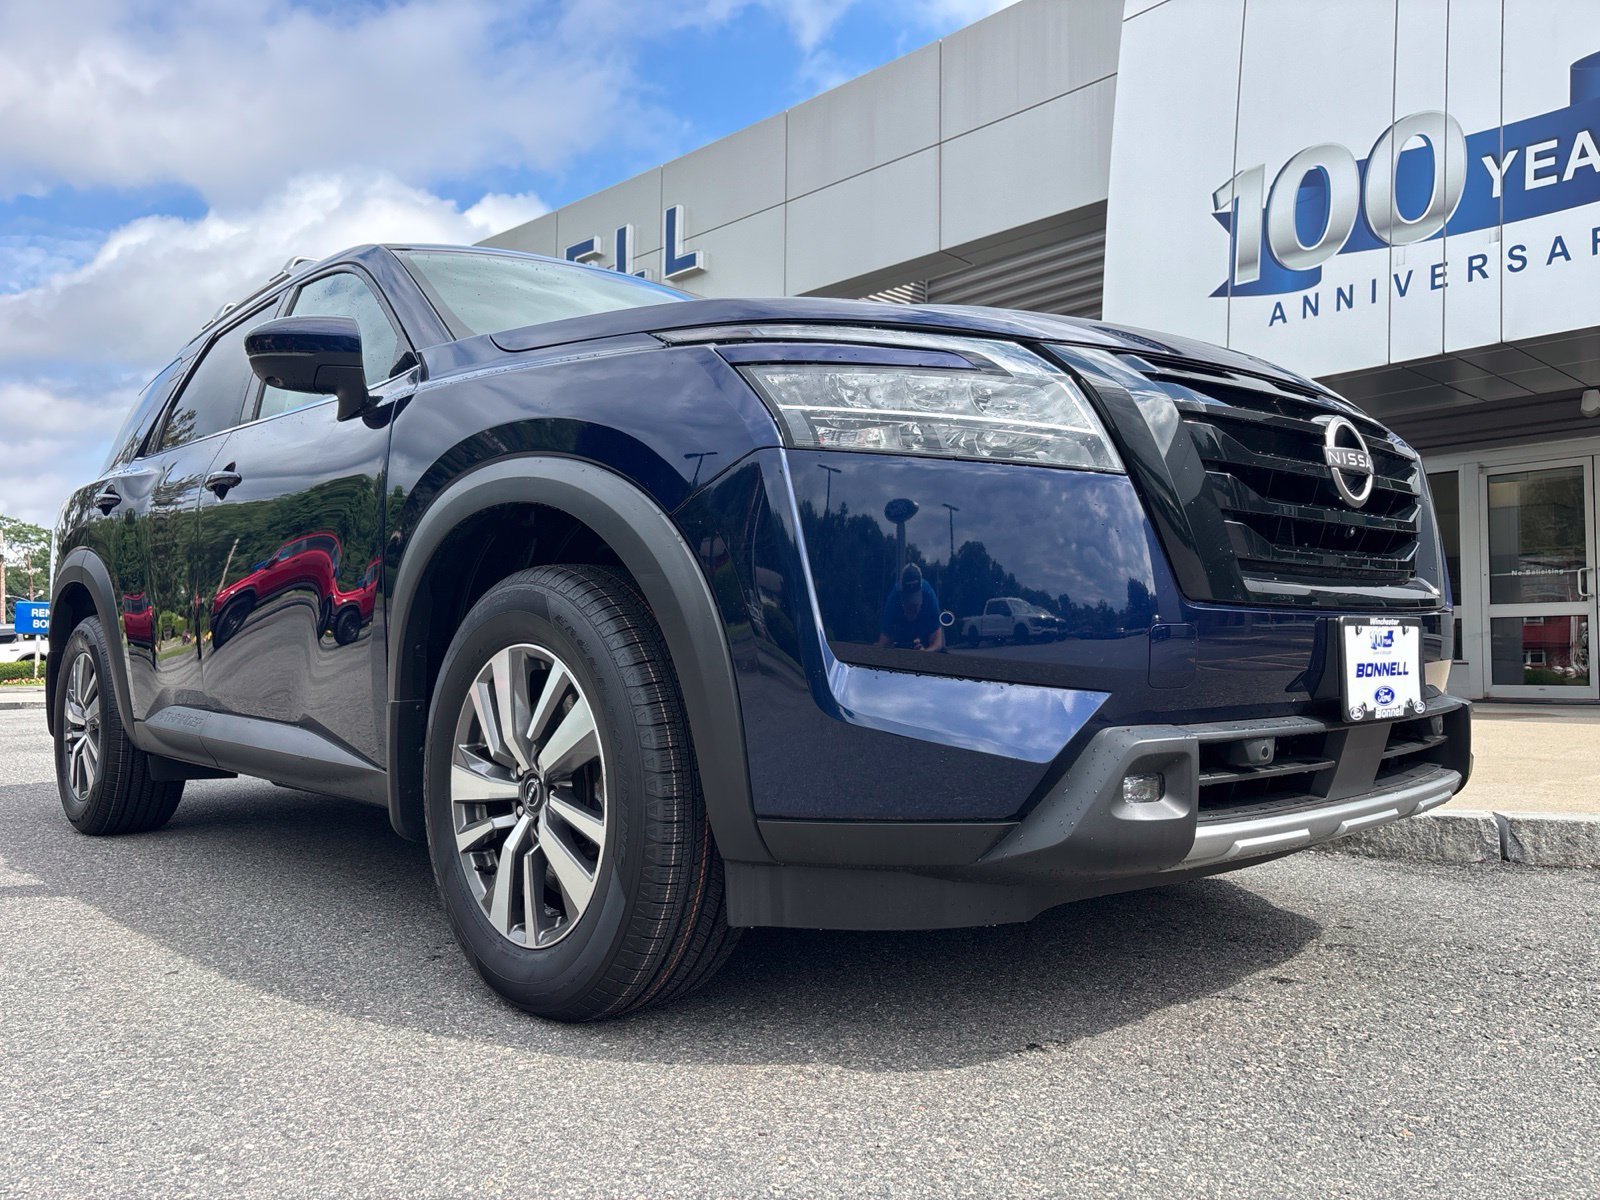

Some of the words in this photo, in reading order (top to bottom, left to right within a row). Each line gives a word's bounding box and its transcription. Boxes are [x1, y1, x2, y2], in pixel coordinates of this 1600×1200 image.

[1212, 110, 1467, 286] 100
[1356, 662, 1409, 678] BONNELL
[1377, 688, 1393, 703] Ford
[1375, 705, 1405, 719] Bonnell
